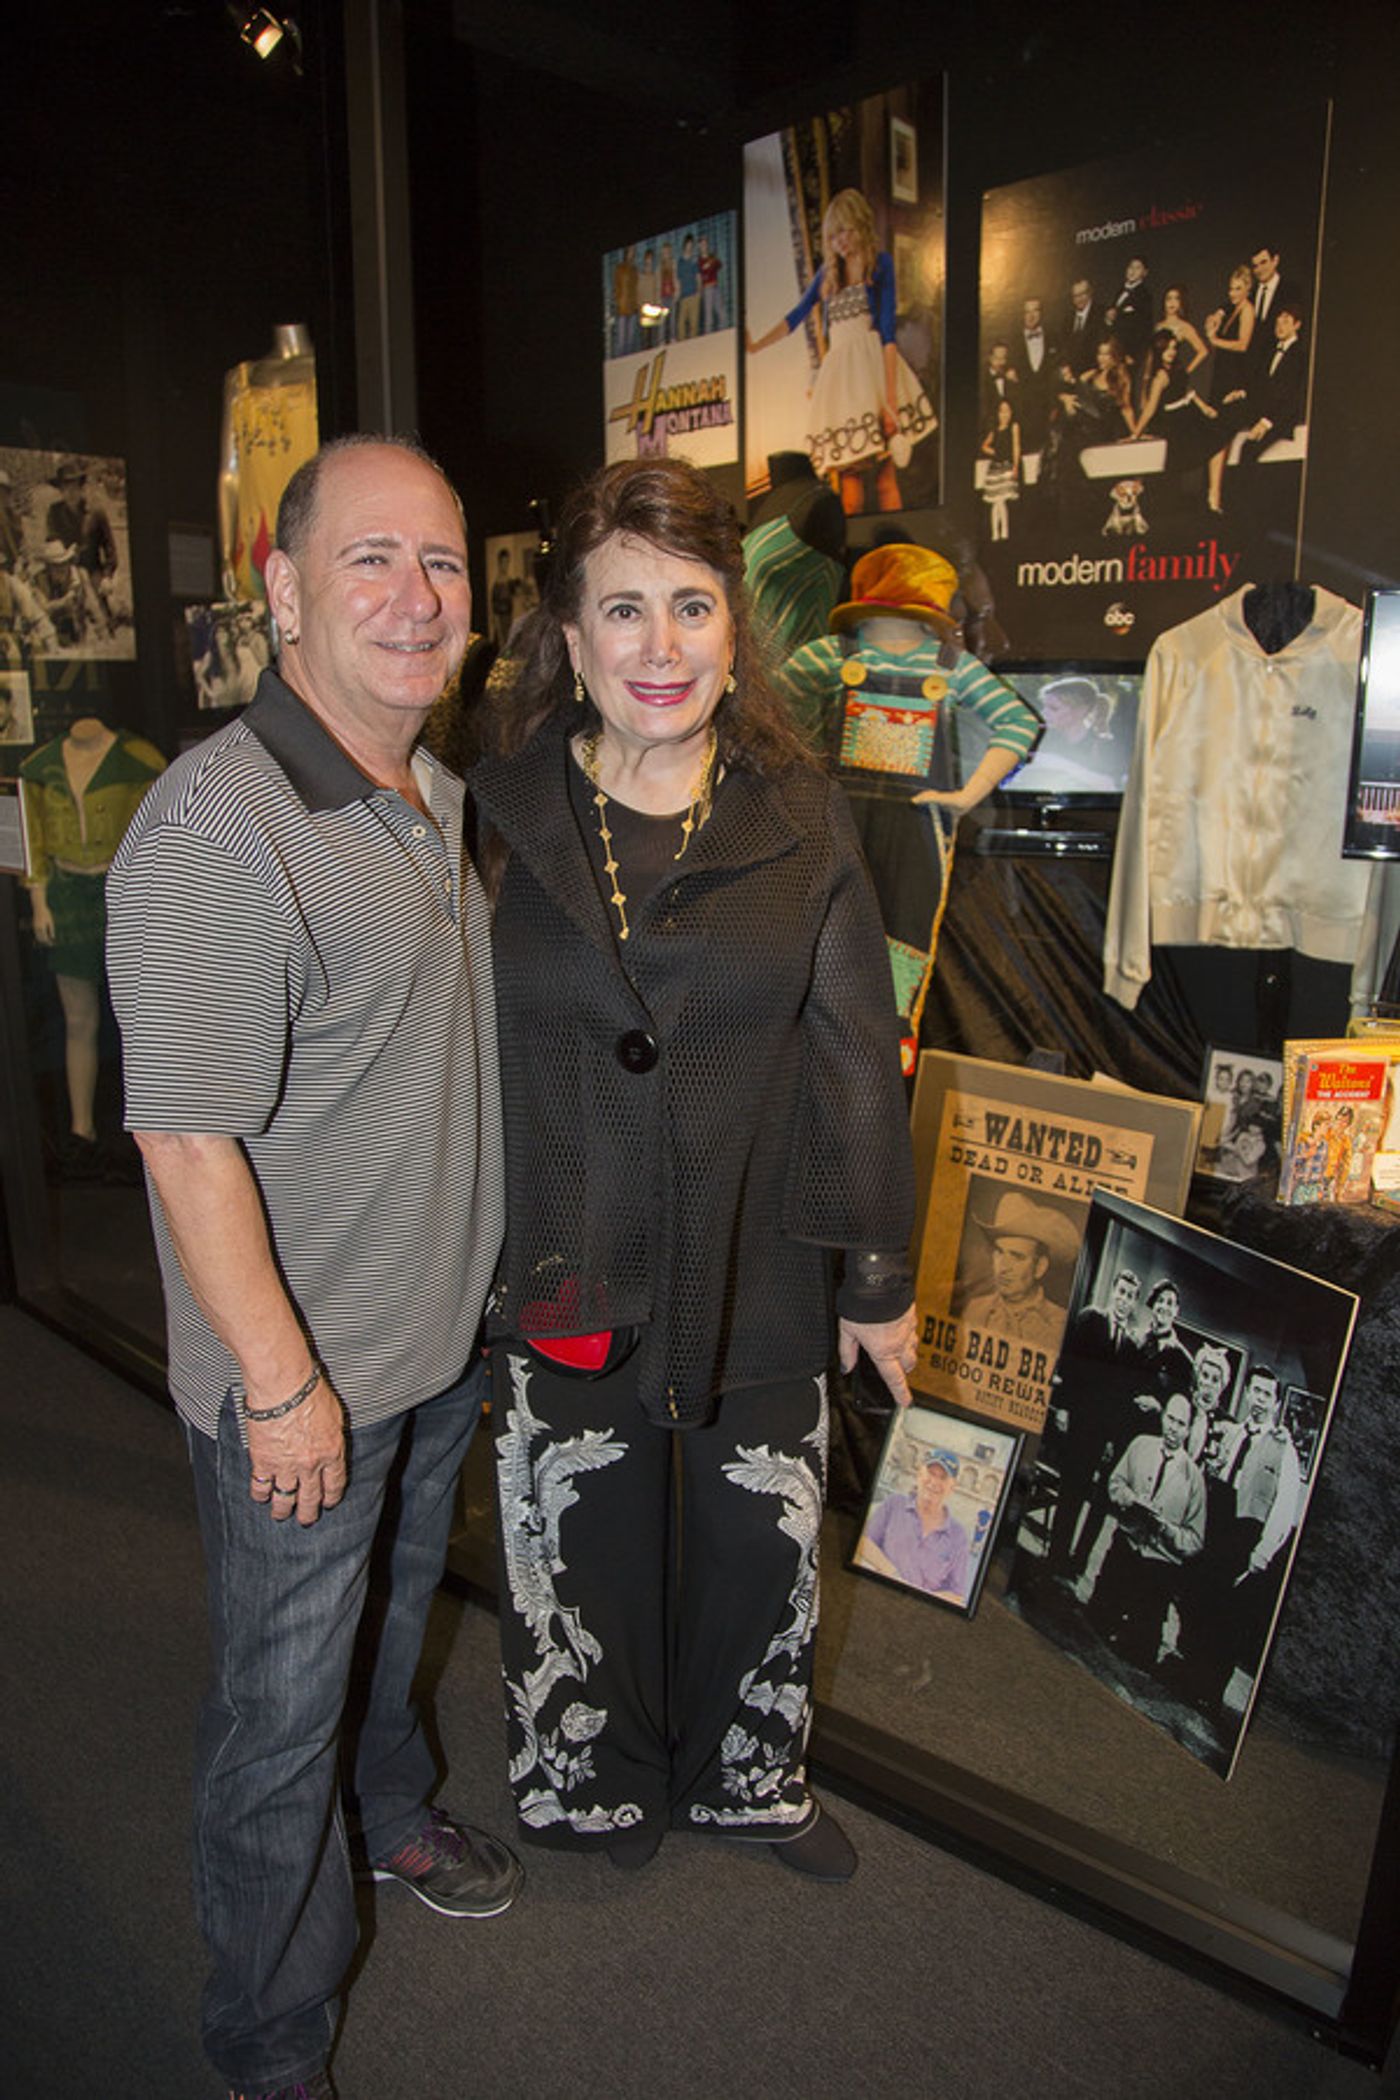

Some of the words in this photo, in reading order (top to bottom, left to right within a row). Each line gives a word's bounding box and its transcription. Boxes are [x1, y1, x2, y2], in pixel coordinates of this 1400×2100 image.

[1075, 219, 1136, 244] modern
[1017, 553, 1124, 587] modern
[1125, 539, 1240, 592] family
[1104, 609, 1135, 627] abc
[985, 1111, 1103, 1169] WANTED
[950, 1146, 1009, 1175] DEAD
[1016, 1163, 1044, 1185] OR
[921, 1315, 957, 1353] BIG
[966, 1330, 1010, 1371] BAD
[1017, 1347, 1053, 1387] BR
[988, 1373, 1046, 1407] REWA
